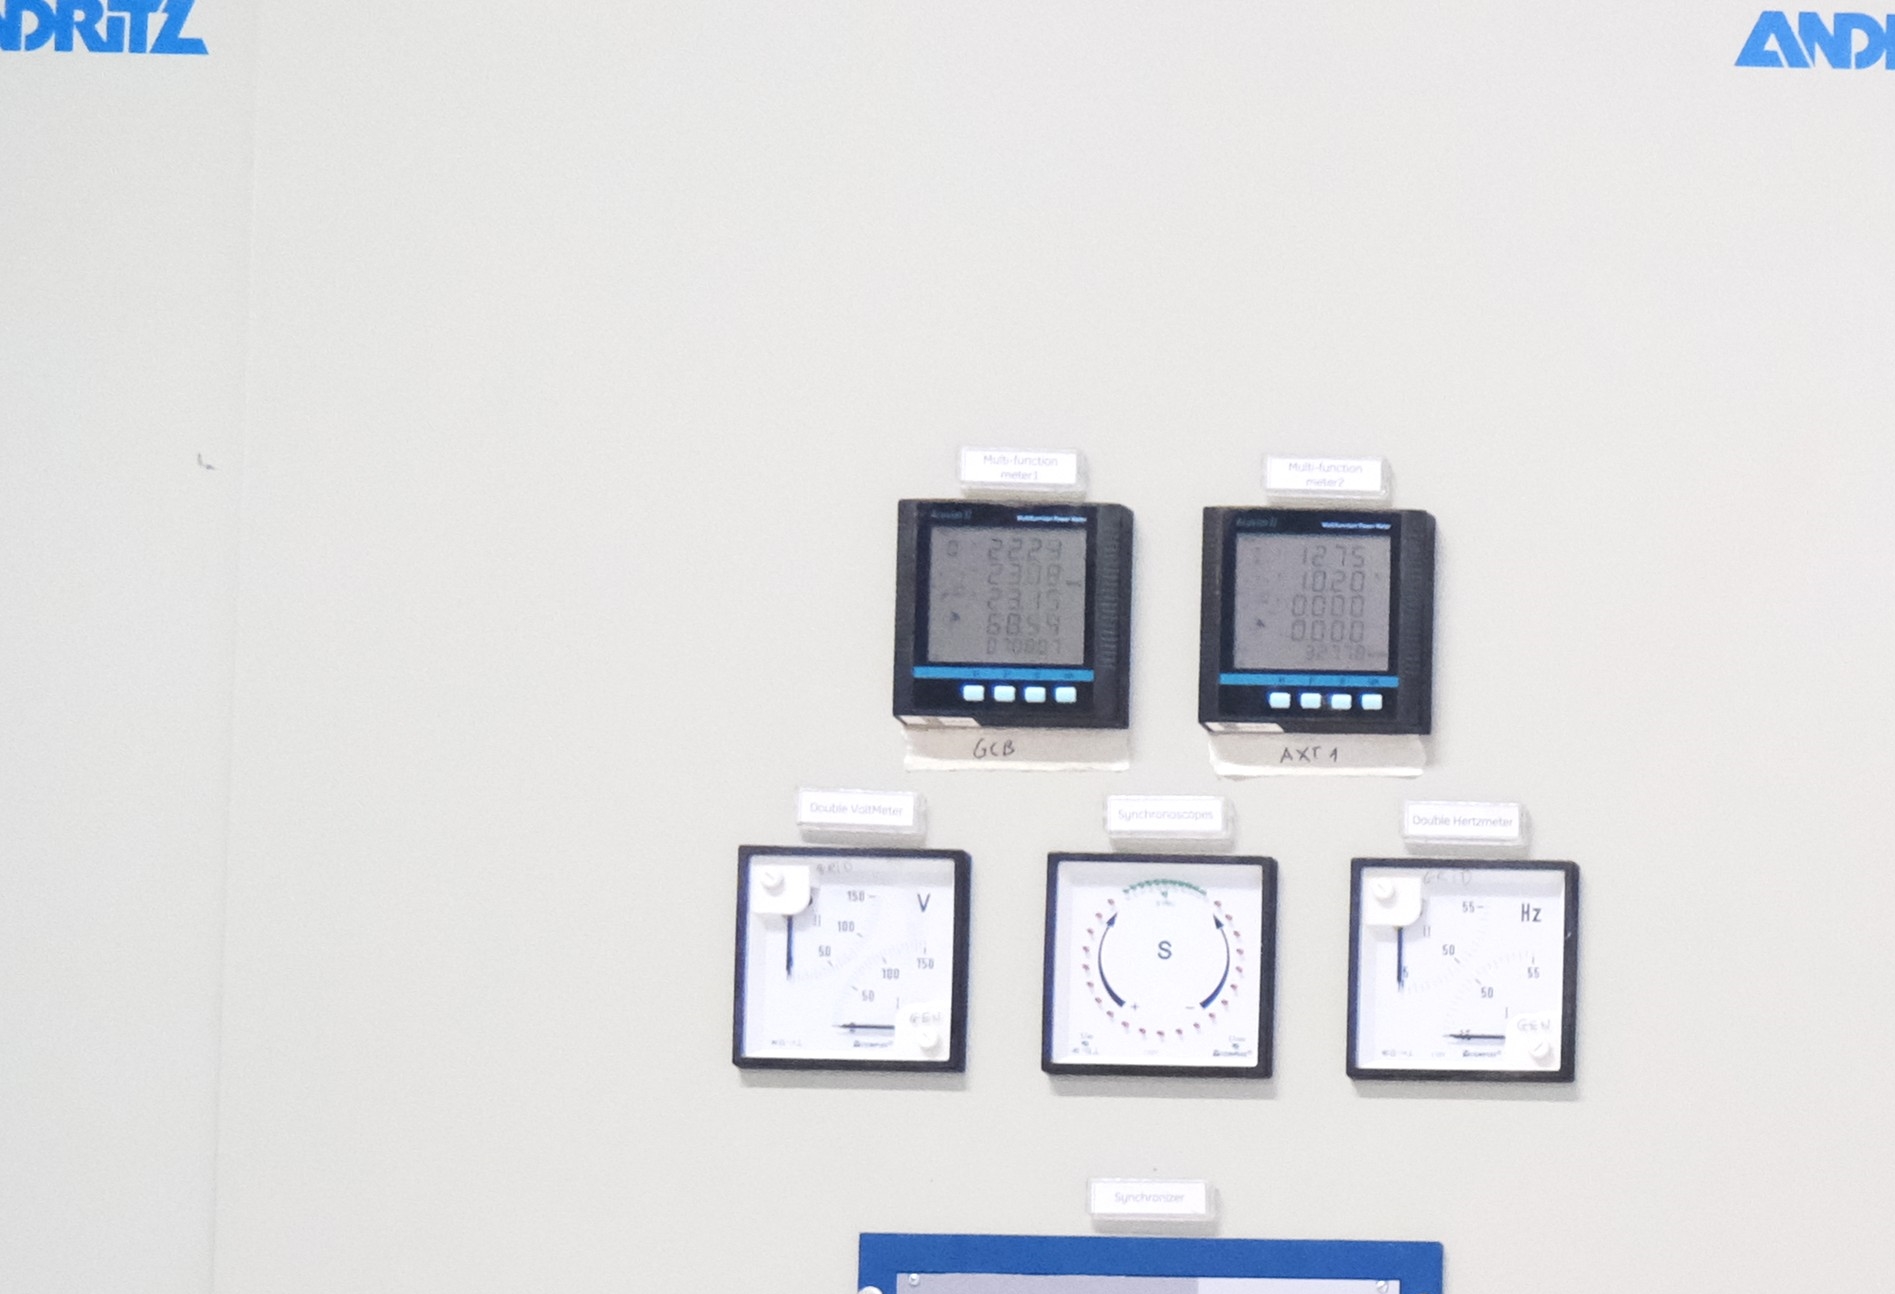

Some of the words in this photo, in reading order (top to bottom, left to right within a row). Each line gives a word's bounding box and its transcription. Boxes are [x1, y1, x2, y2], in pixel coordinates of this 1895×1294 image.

[983, 455, 1058, 467] Multi-function
[1288, 462, 1363, 473] Multi-function
[973, 738, 1016, 759] GCB
[810, 802, 848, 814] Double
[850, 803, 903, 815] VoltMeter
[1118, 809, 1214, 821] Synchronoscopes
[1412, 814, 1450, 826] Double
[1453, 815, 1512, 827] Hertzmeter
[847, 891, 865, 901] 150
[917, 893, 930, 912] V
[1462, 902, 1475, 913] 55
[1521, 903, 1541, 922] Hz
[837, 921, 855, 932] 100
[1157, 940, 1172, 960] S
[1442, 944, 1455, 956] 50
[916, 958, 934, 969] 150
[882, 969, 900, 980] 100
[1527, 968, 1540, 978] 55
[1481, 987, 1493, 998] 50
